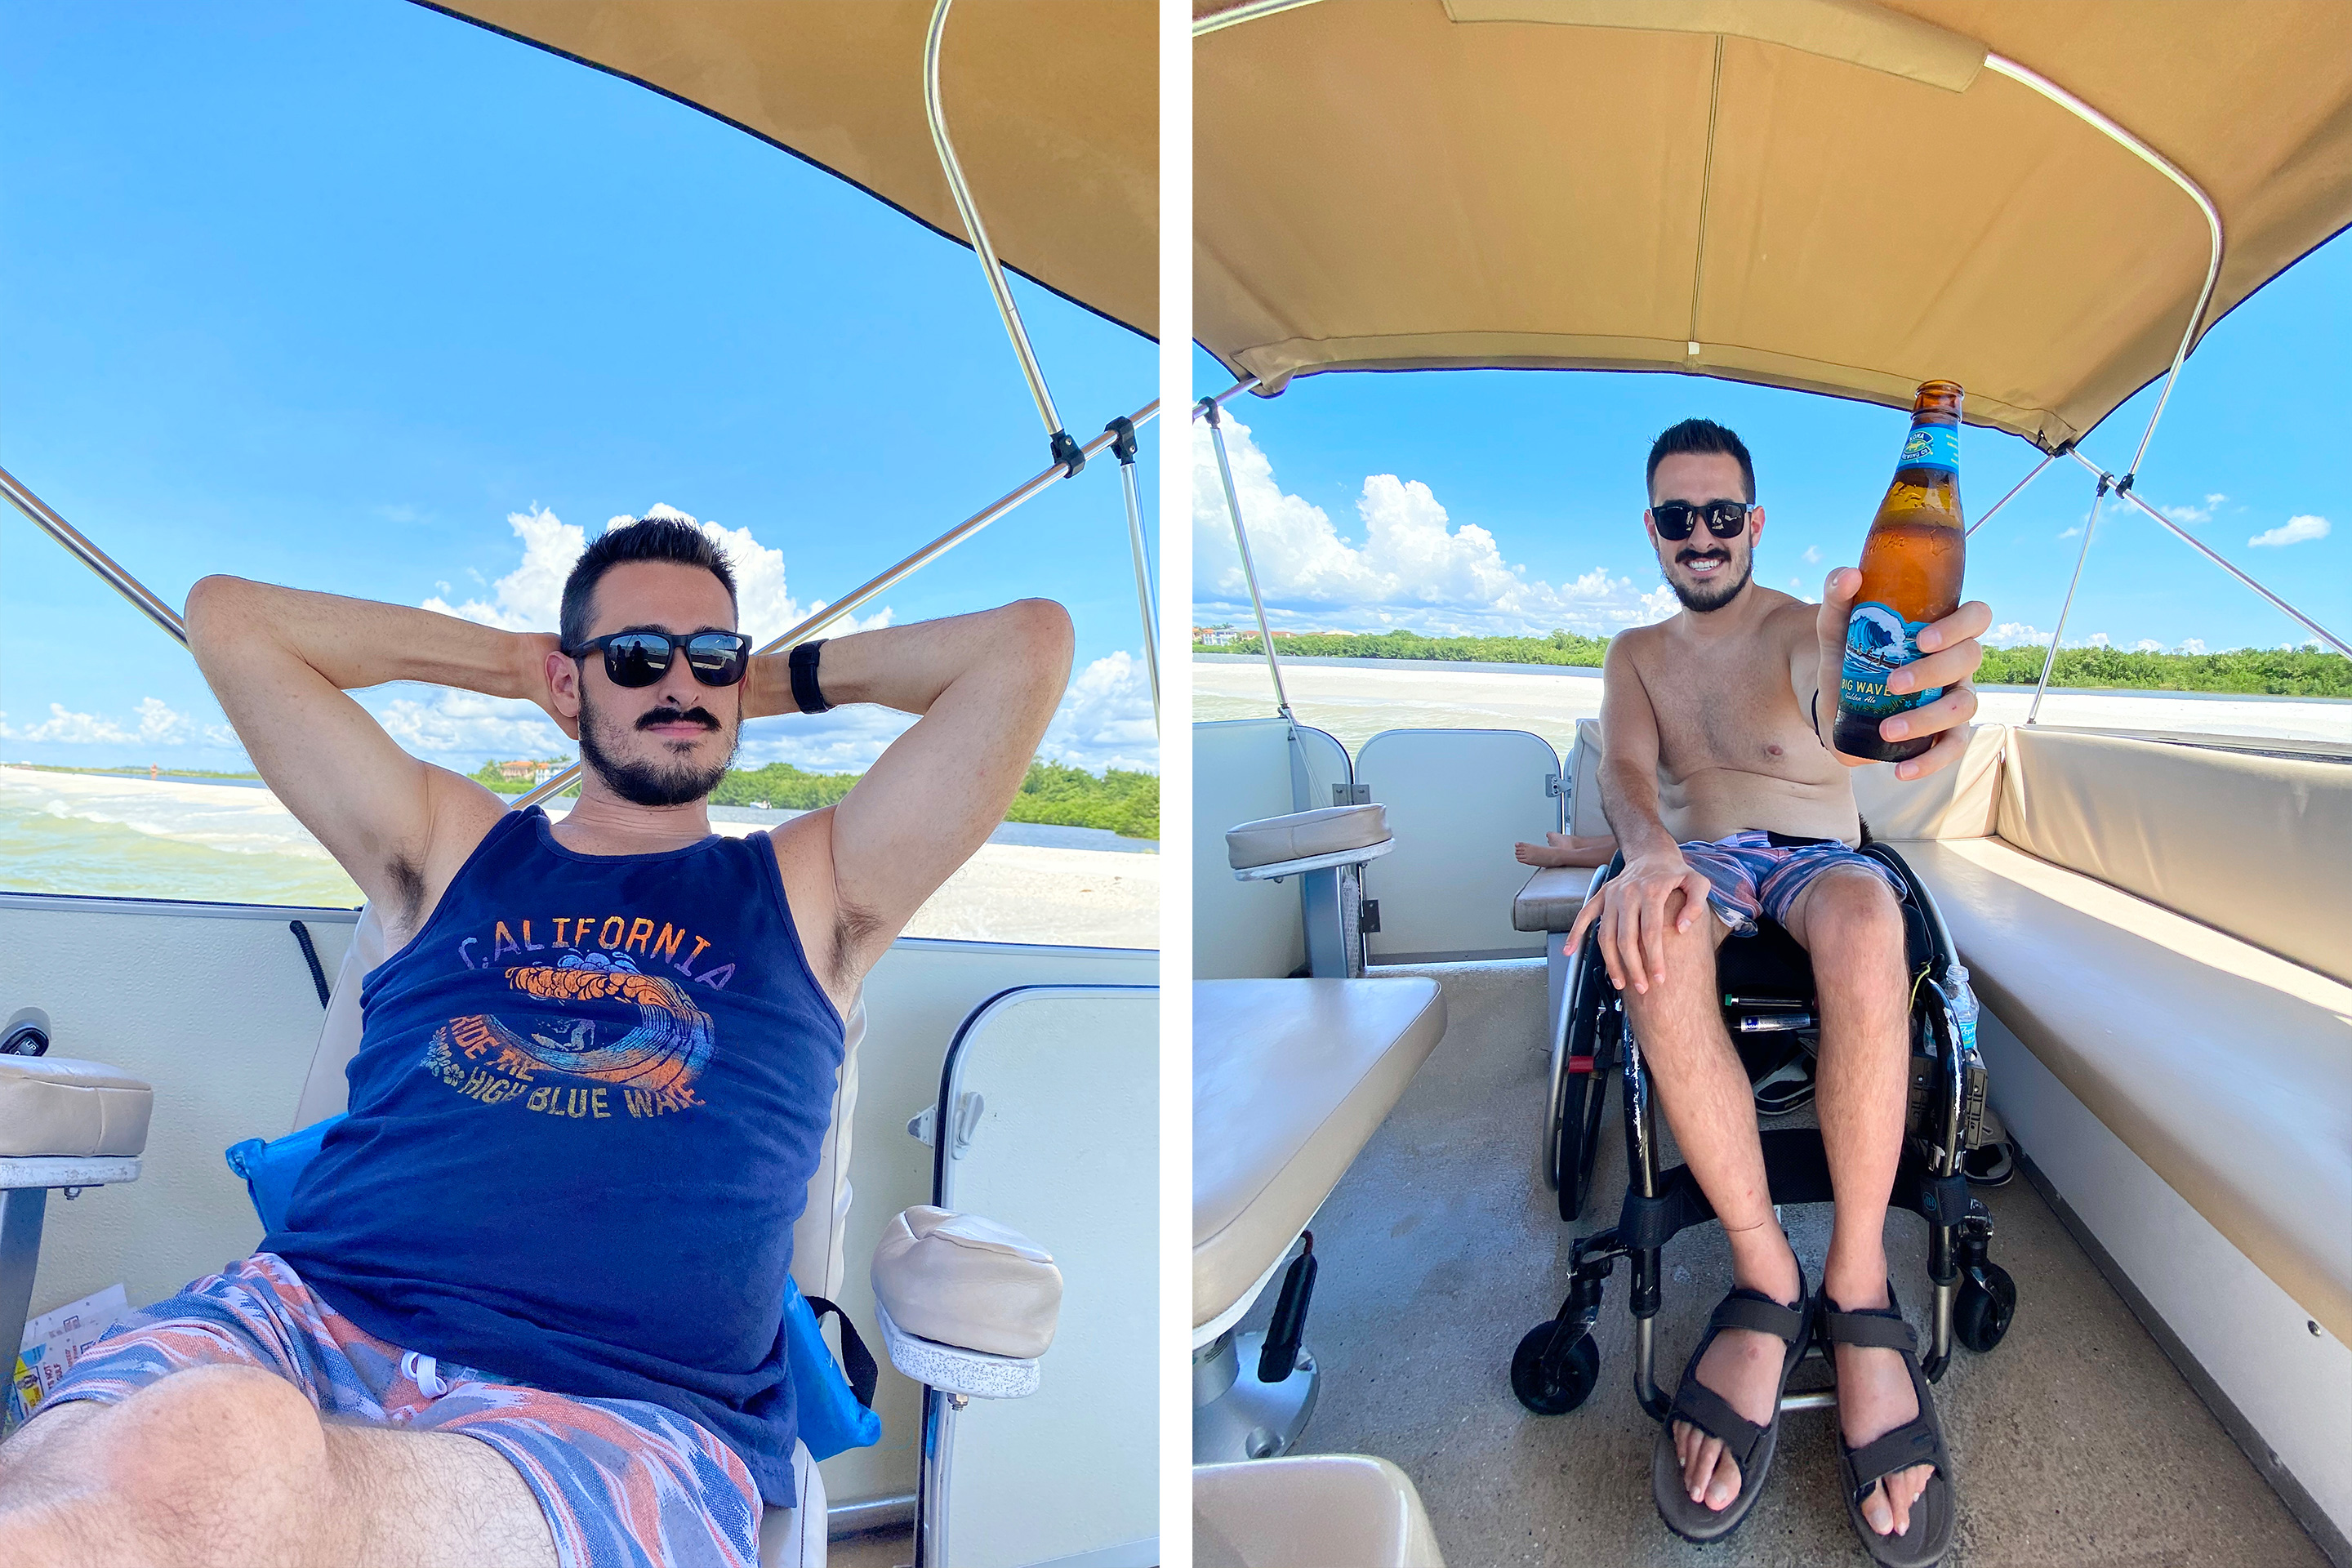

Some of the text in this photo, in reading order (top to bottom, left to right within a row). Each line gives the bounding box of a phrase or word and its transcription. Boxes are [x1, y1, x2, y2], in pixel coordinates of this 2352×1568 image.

[1841, 678, 1892, 697] BIG WAVE
[1845, 692, 1877, 704] Golden Ale
[457, 915, 736, 991] CALIFORNIA
[25, 1040, 37, 1050] UP
[449, 1014, 500, 1060] RIDE
[457, 1066, 528, 1104] HIGH
[526, 1086, 612, 1119] BLUE
